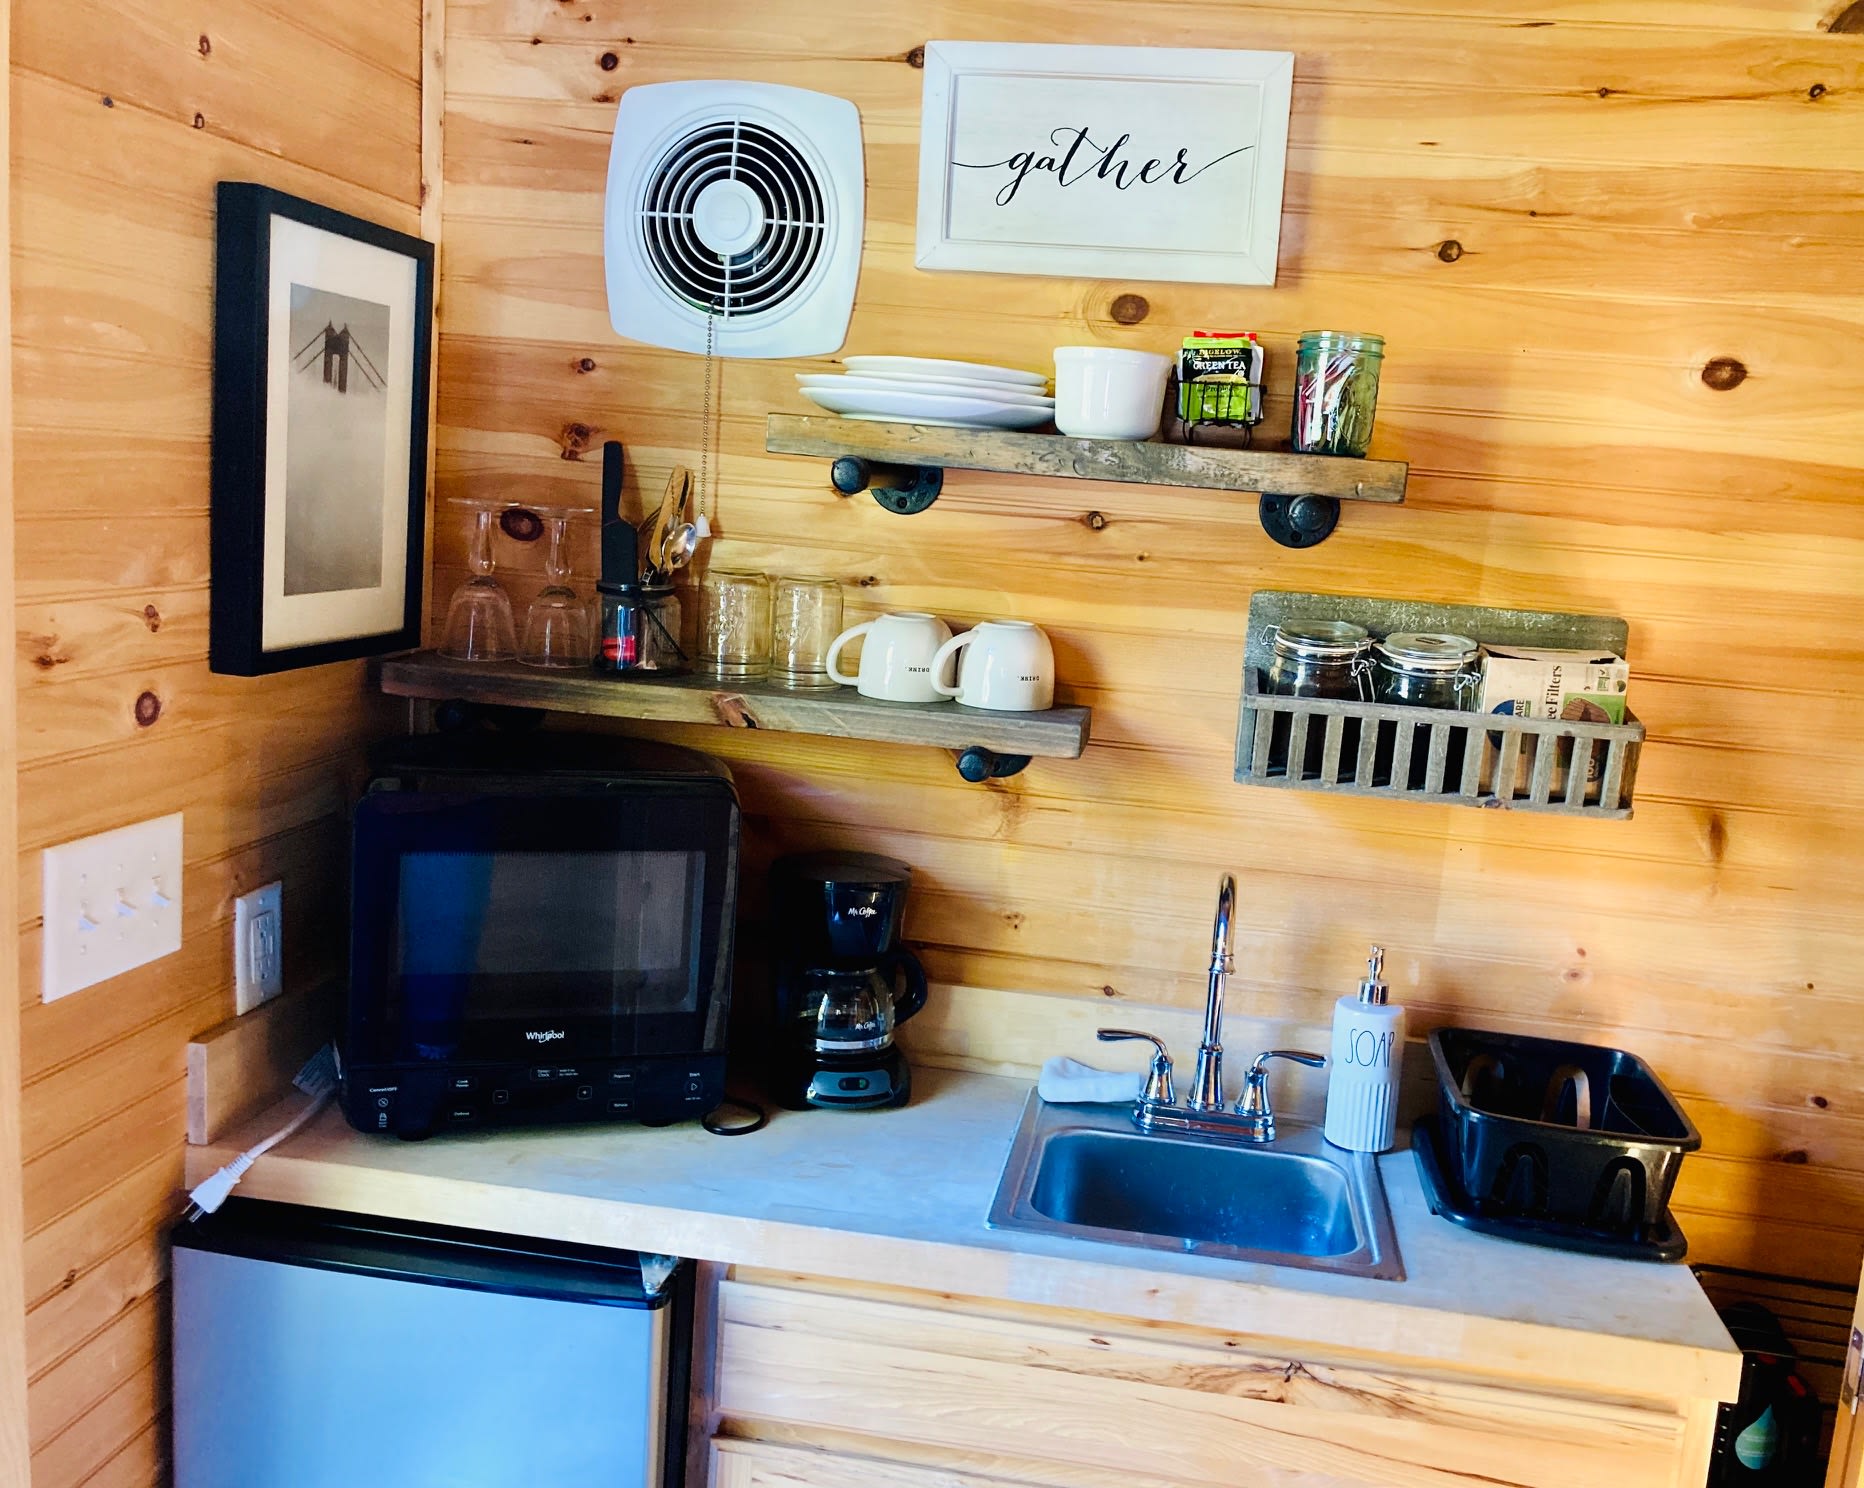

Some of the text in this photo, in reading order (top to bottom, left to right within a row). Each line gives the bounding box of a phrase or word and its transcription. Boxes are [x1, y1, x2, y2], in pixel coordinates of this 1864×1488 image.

[951, 127, 1254, 206] gather
[1193, 360, 1247, 370] GREEN TEA
[1545, 665, 1562, 706] Filters
[525, 1030, 565, 1043] Whirlpool
[1345, 1028, 1395, 1068] SOAP
